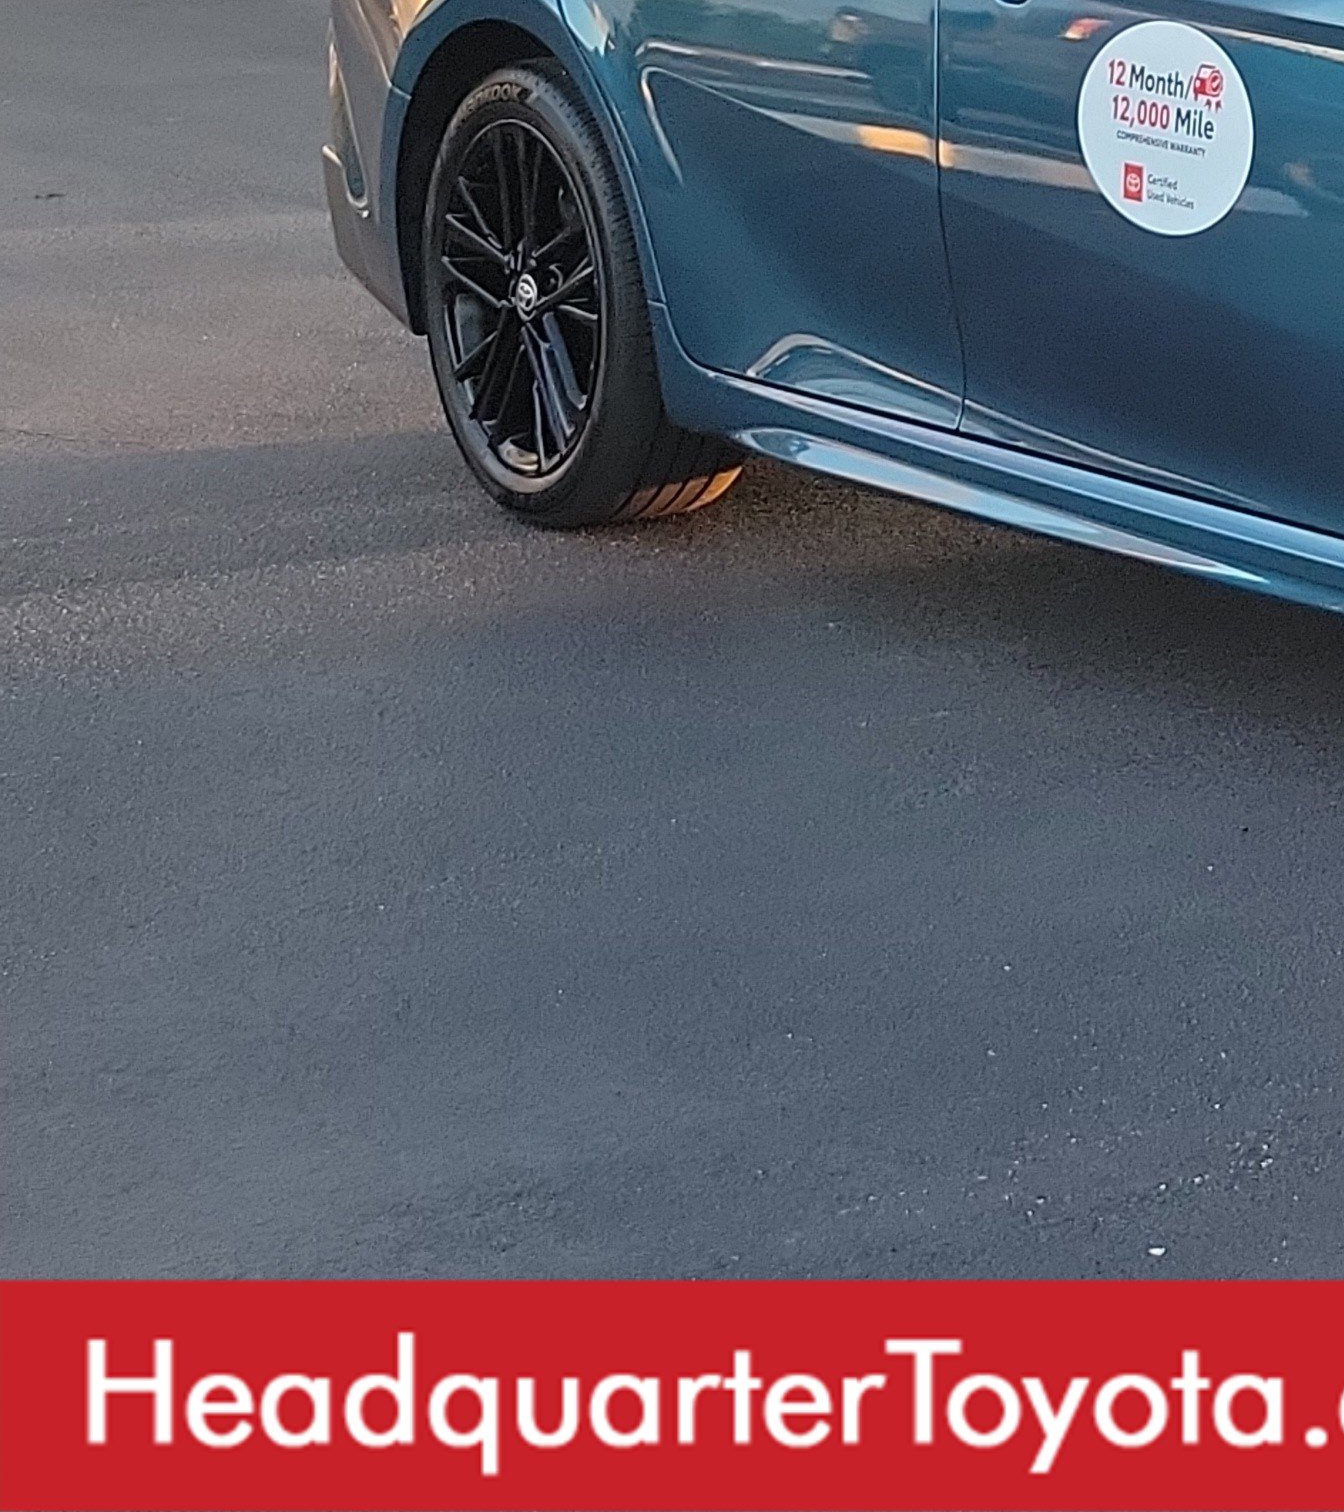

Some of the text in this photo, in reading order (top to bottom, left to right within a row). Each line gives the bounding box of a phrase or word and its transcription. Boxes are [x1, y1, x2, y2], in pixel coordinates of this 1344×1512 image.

[1108, 59, 1194, 101] 12 Month/
[1111, 94, 1215, 140] 12,000 Mile
[1169, 141, 1206, 157] WARRANTY
